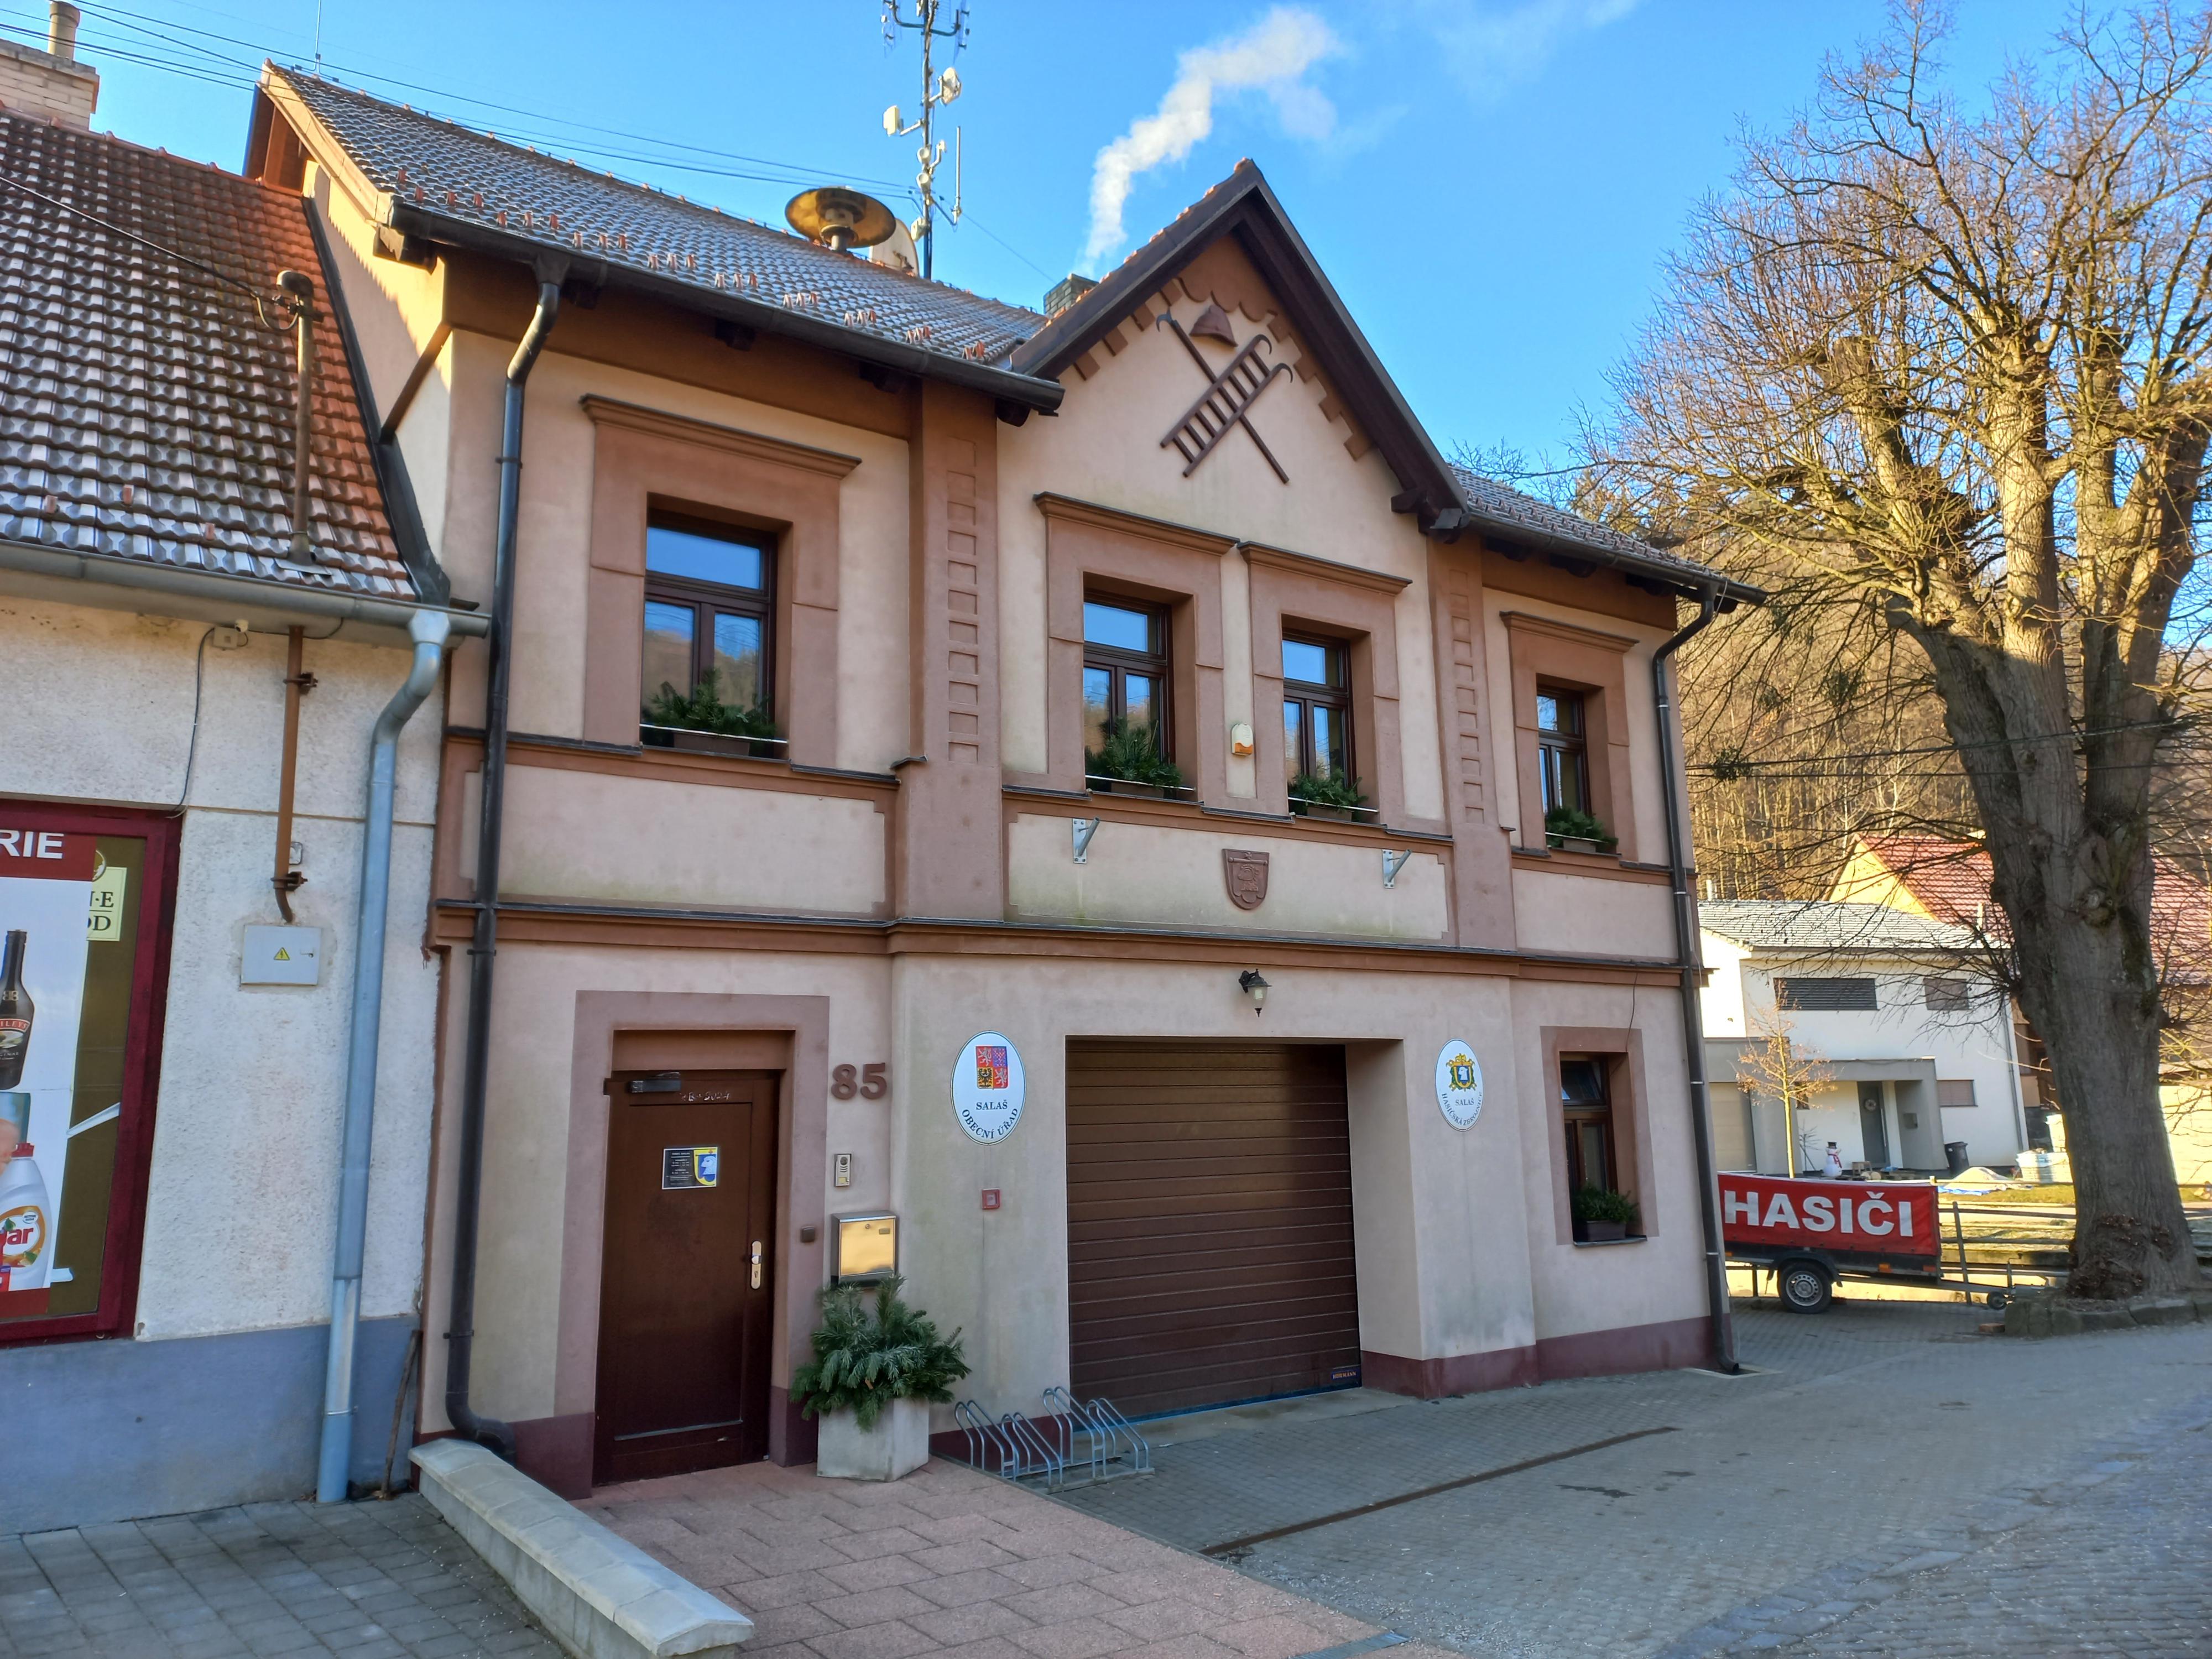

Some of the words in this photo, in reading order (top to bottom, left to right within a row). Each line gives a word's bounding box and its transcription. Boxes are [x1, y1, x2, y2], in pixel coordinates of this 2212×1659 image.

[831, 1062, 888, 1100] 85
[975, 1099, 1008, 1110] SALAŠ
[1442, 1093, 1462, 1125] HASIČSKÁ
[1455, 1098, 1474, 1106] SALAŠ
[962, 1109, 995, 1139] OBECNÍ
[997, 1108, 1018, 1136] ÚŘAD
[1724, 1191, 1913, 1237] HASIČI
